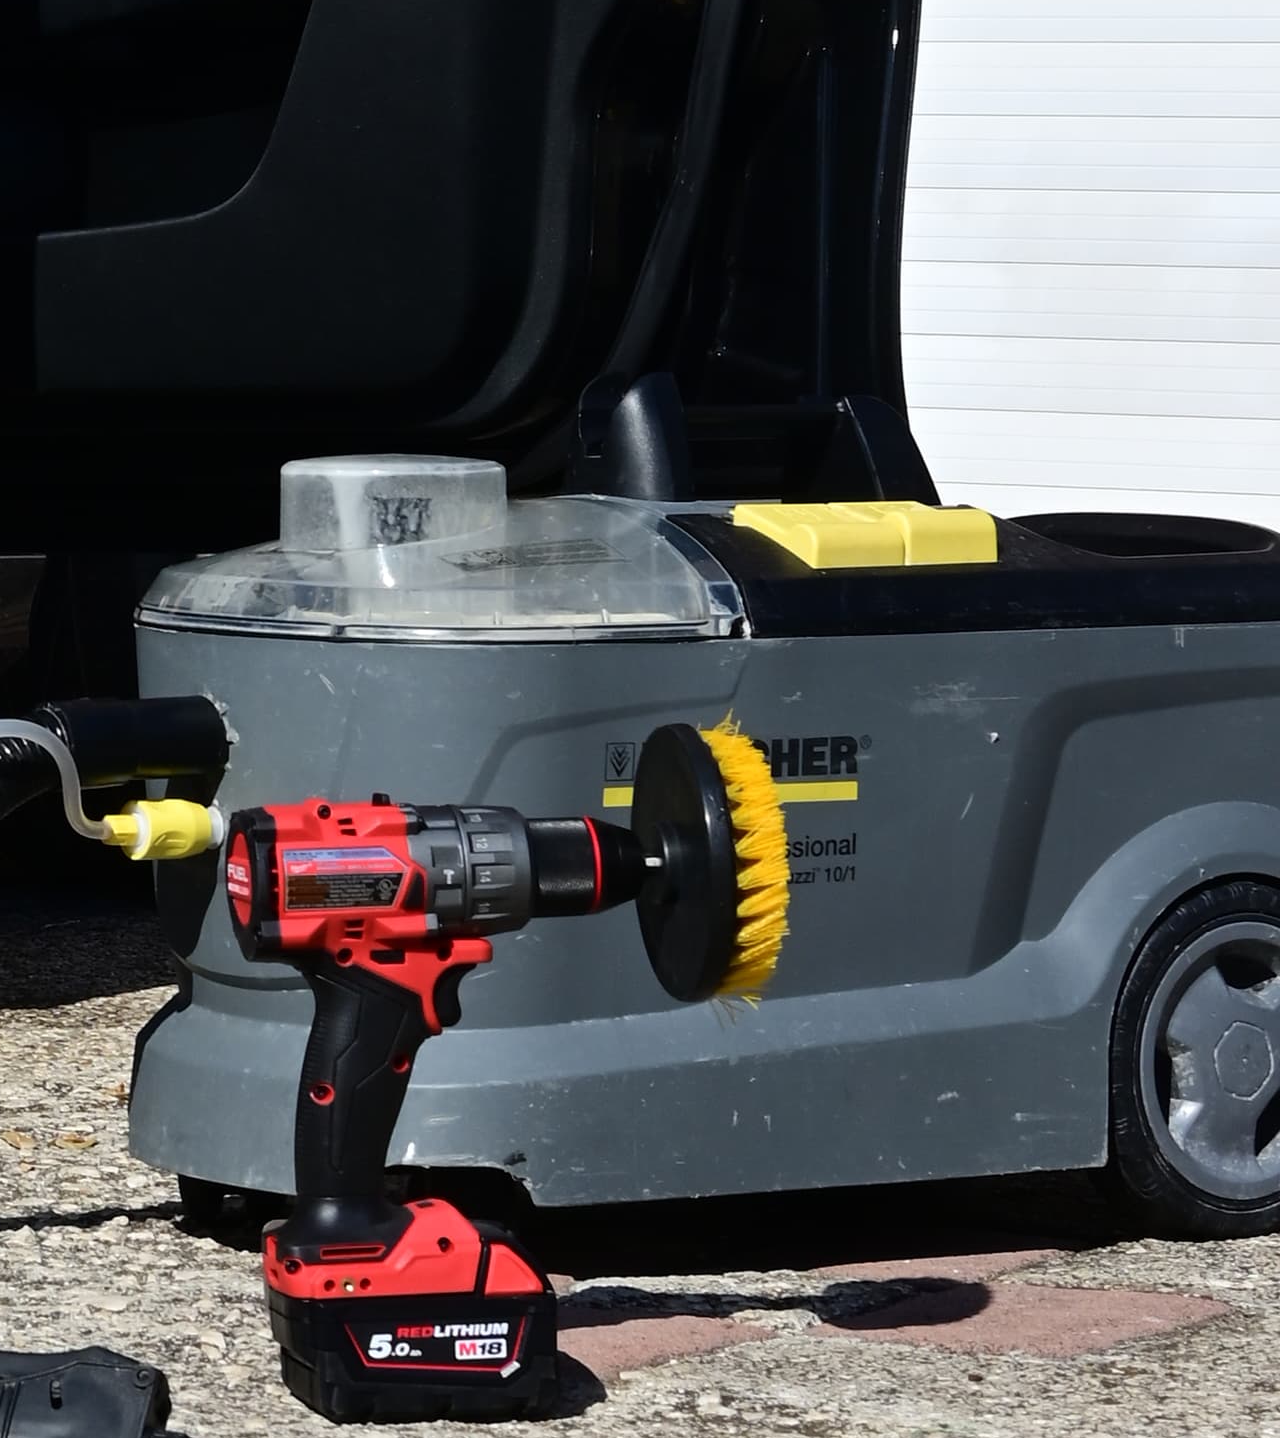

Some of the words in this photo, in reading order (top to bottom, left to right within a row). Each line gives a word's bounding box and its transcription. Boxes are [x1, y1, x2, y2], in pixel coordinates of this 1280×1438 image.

[824, 866, 856, 883] 10/1
[397, 1323, 509, 1339] REDLITHIUM
[459, 1342, 502, 1356] M18
